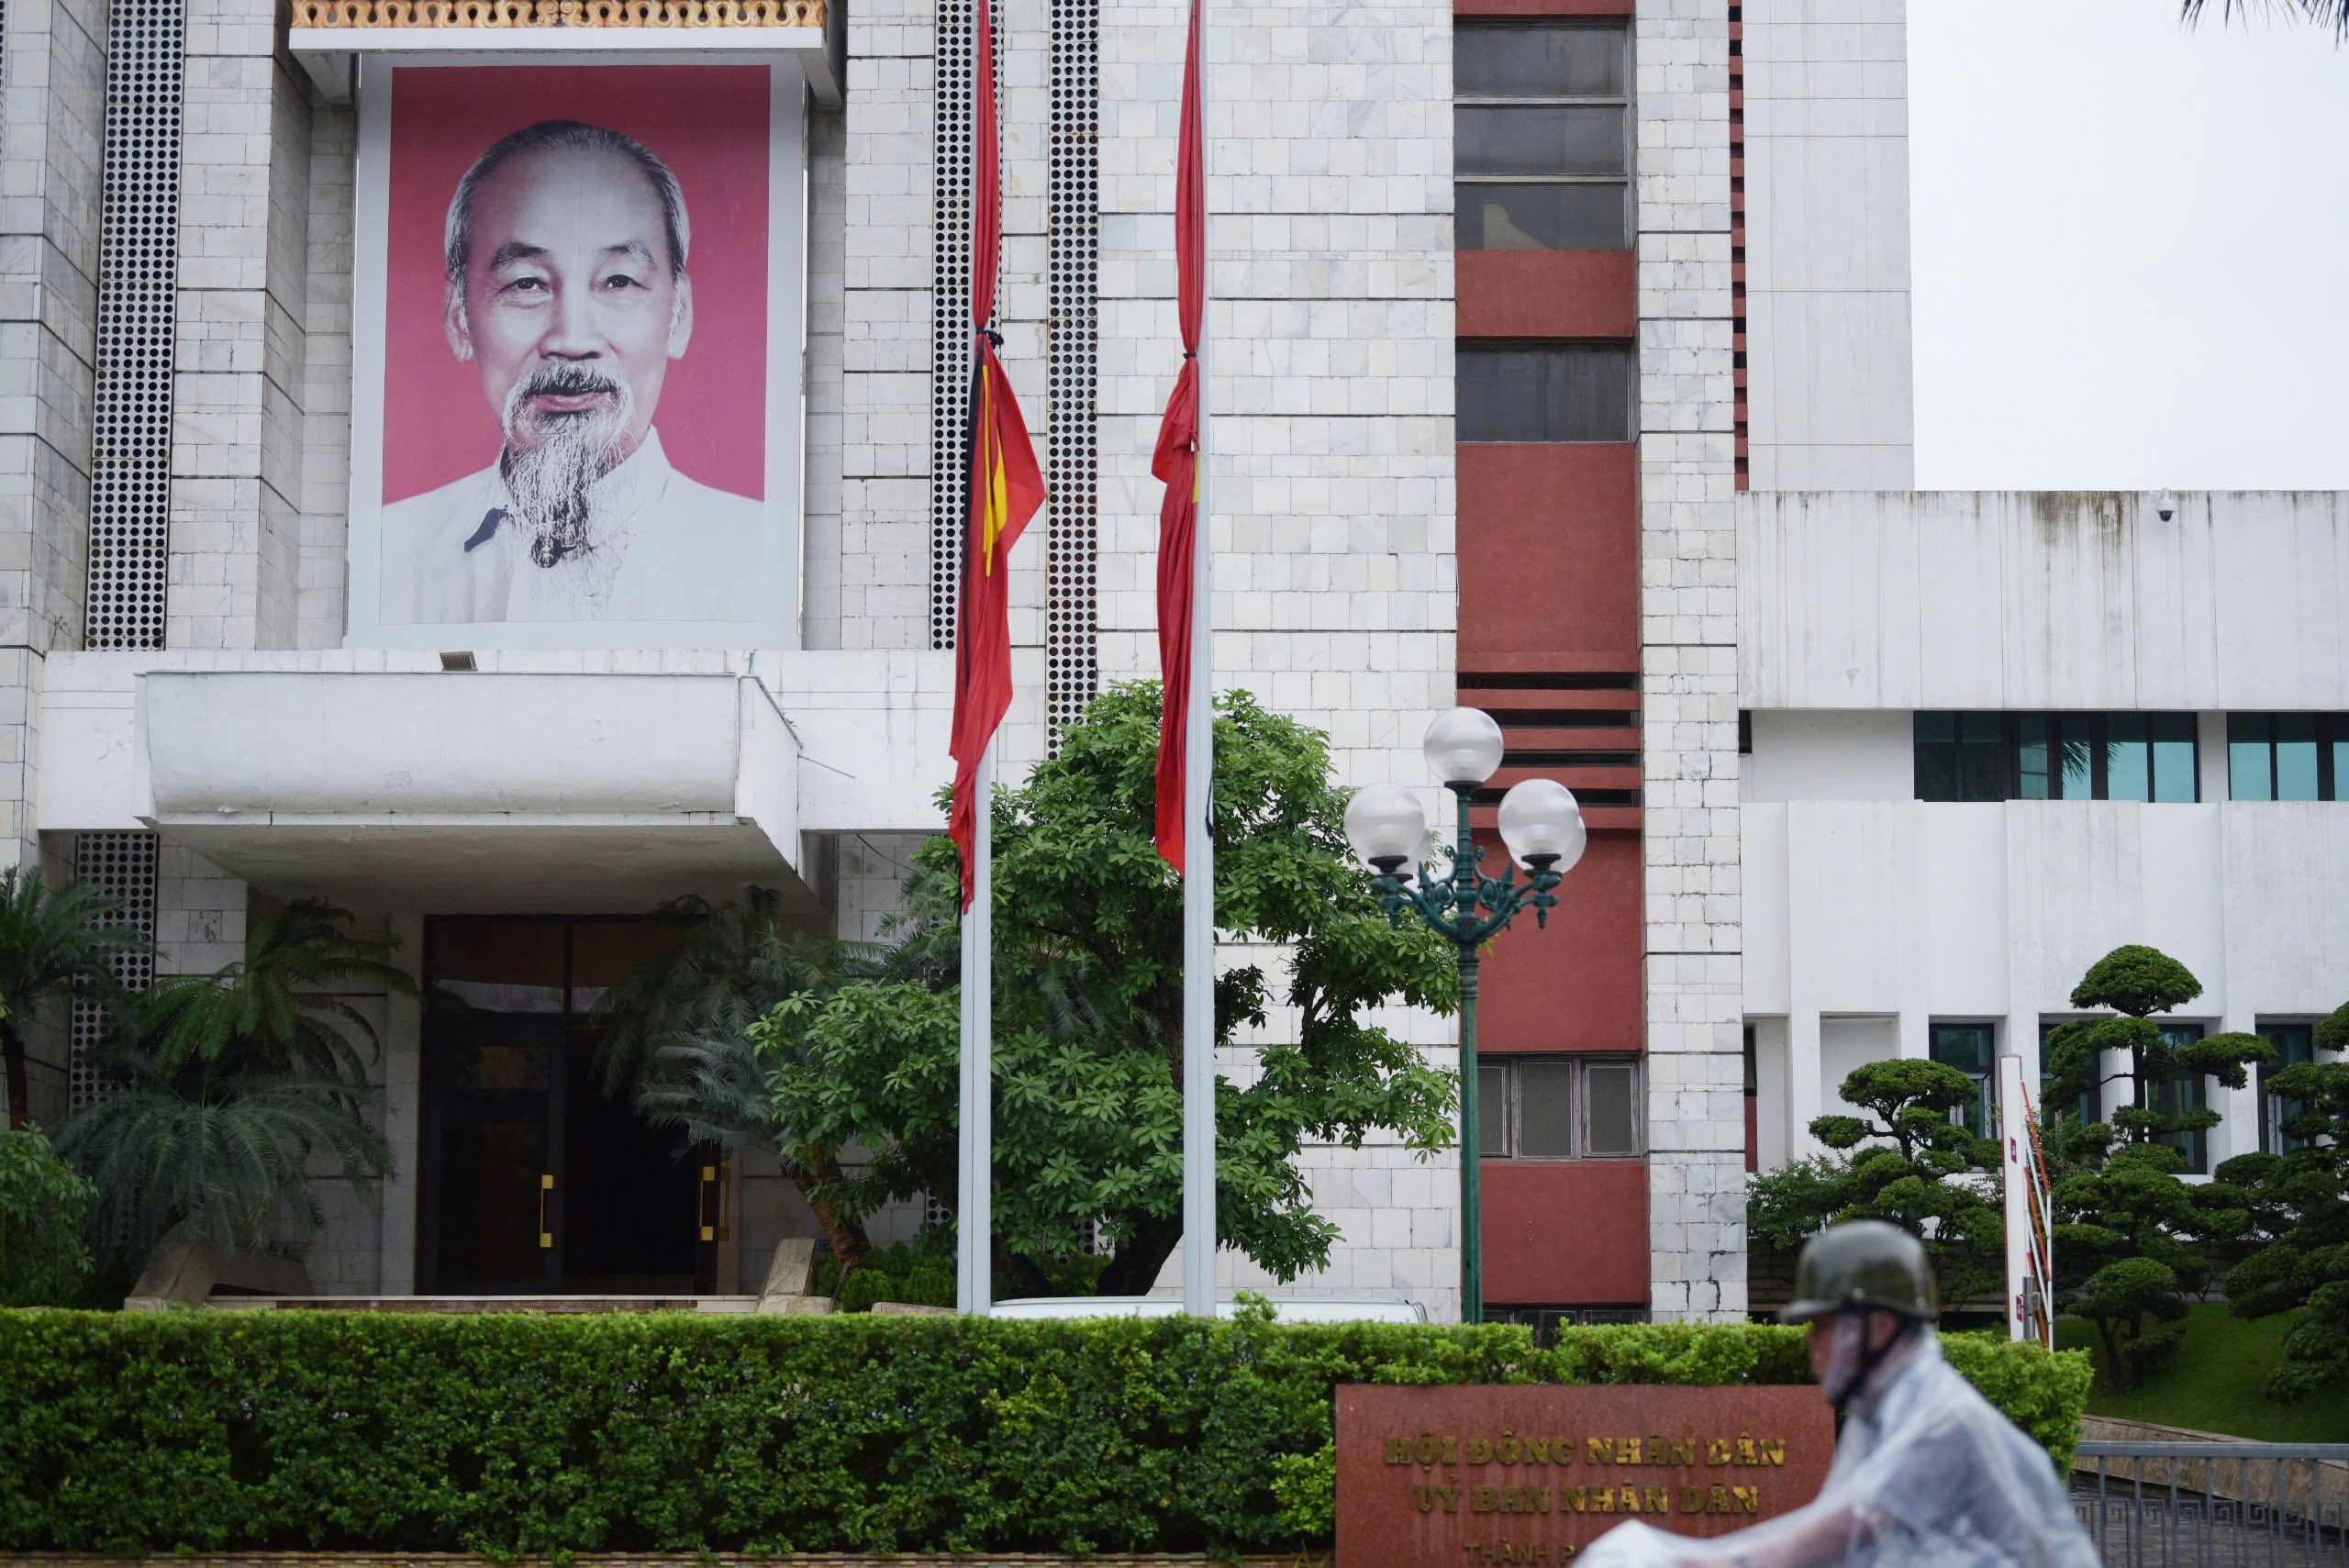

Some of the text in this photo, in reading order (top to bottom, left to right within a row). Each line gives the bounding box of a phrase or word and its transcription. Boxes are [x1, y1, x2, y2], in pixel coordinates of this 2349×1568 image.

[1385, 1428, 1786, 1472] HỘI ĐỒNG NHÂN DÂN
[1471, 1485, 1551, 1513] BAN
[1561, 1477, 1670, 1513] NHÂN
[1679, 1478, 1759, 1513] DÂN
